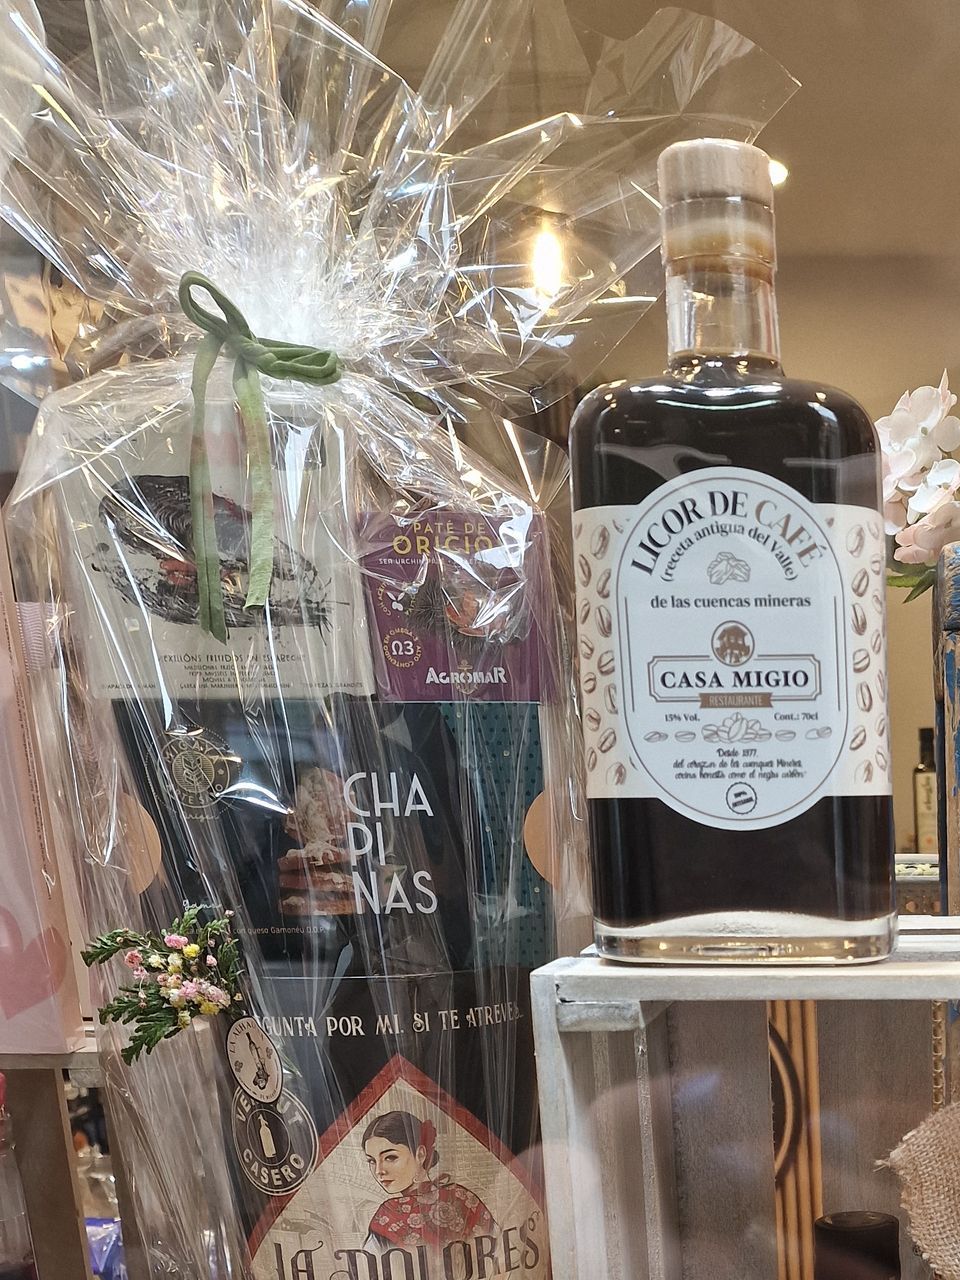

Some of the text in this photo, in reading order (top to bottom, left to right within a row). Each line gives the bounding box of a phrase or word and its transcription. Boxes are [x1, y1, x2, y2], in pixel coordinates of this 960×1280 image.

[414, 520, 485, 534] PATÉ DE
[632, 490, 827, 576] LICOR DE CAFÉ
[392, 536, 493, 555] ORICIO
[661, 520, 799, 582] (receta antigua del Valle)
[651, 595, 811, 608] de las cuencas mineras
[426, 667, 507, 684] AGROMAR
[660, 670, 809, 688] CASA MIGIO
[709, 695, 763, 706] RESTAURANTE
[665, 712, 818, 722] 15% Vol. Cont.: 70cl
[343, 772, 433, 817] CHA
[348, 823, 386, 866] PI
[352, 871, 438, 915] NAS
[257, 1015, 317, 1036] GUNTA
[327, 1017, 365, 1037] POR
[412, 1010, 430, 1033] SI
[438, 1010, 460, 1030] TE
[243, 1148, 306, 1186] CASERO
